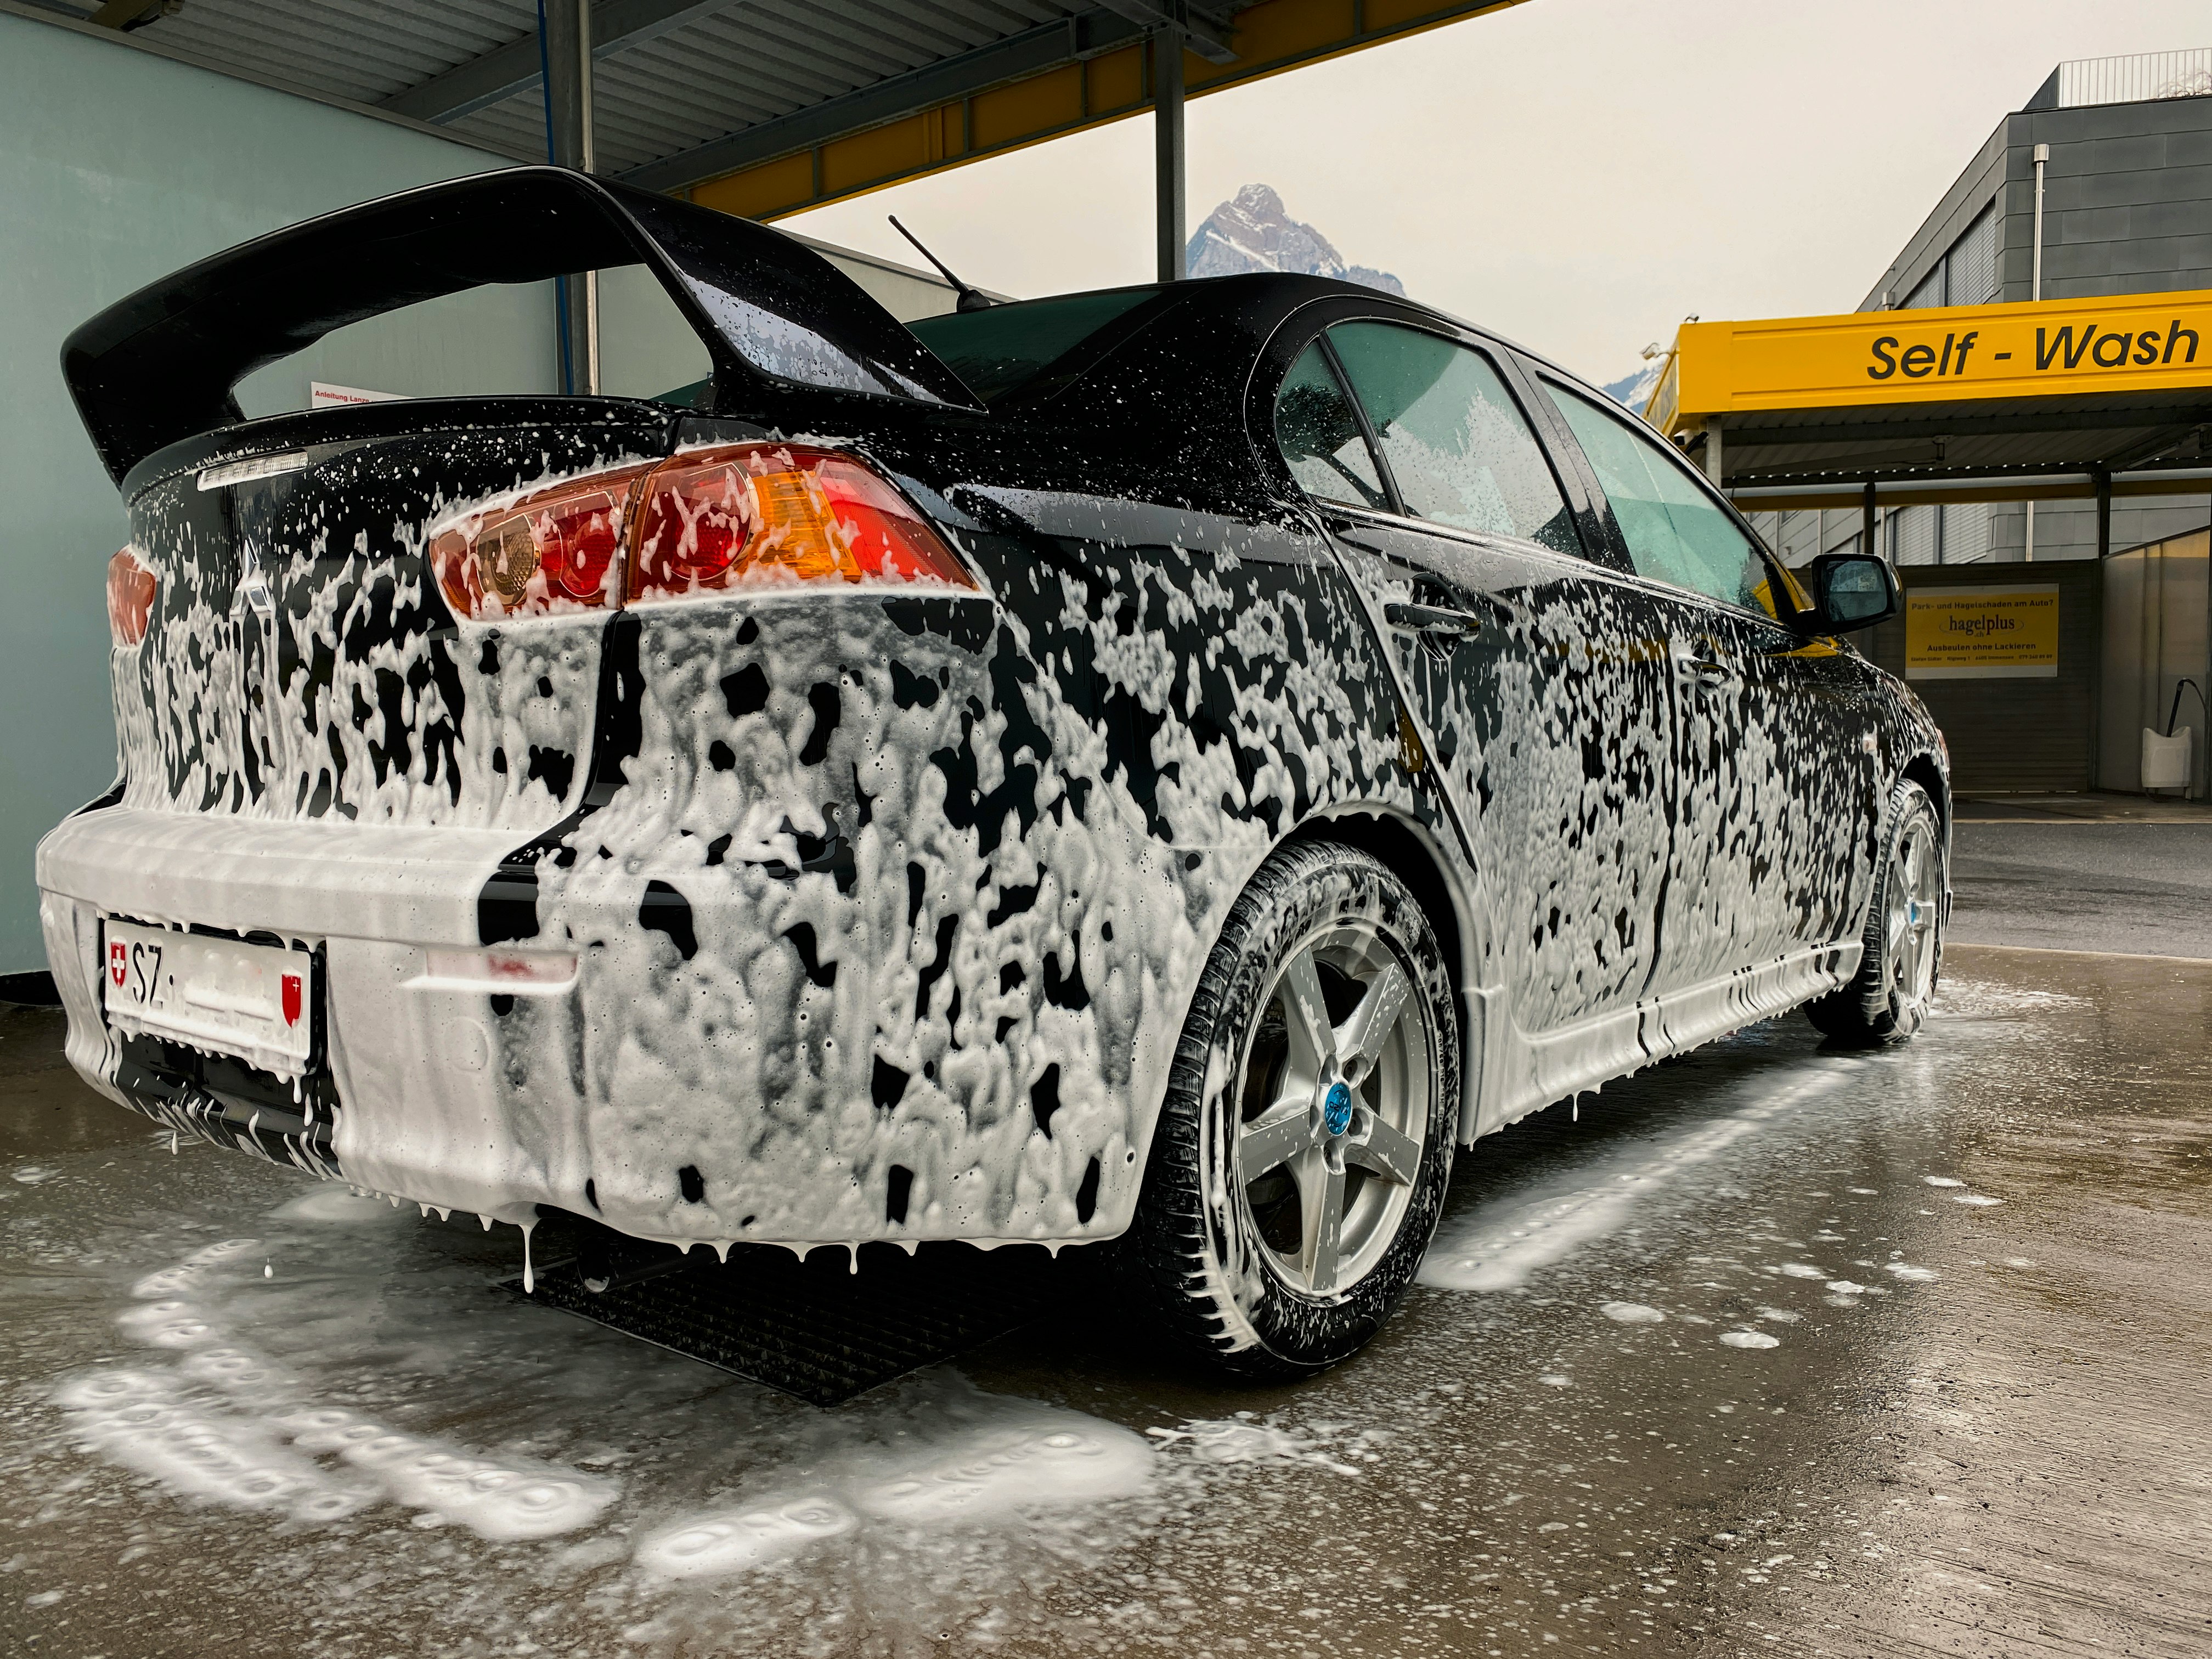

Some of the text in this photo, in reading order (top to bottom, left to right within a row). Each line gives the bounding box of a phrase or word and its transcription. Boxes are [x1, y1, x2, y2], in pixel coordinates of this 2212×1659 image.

[1866, 319, 2199, 380] Self - Wash
[315, 390, 369, 403] Anleitung Lanze
[1954, 600, 2012, 611] Hagelschaden
[2029, 599, 2054, 607] Auto?
[1949, 614, 2015, 636] hagelplus
[1927, 644, 1970, 652] Ausbeulen
